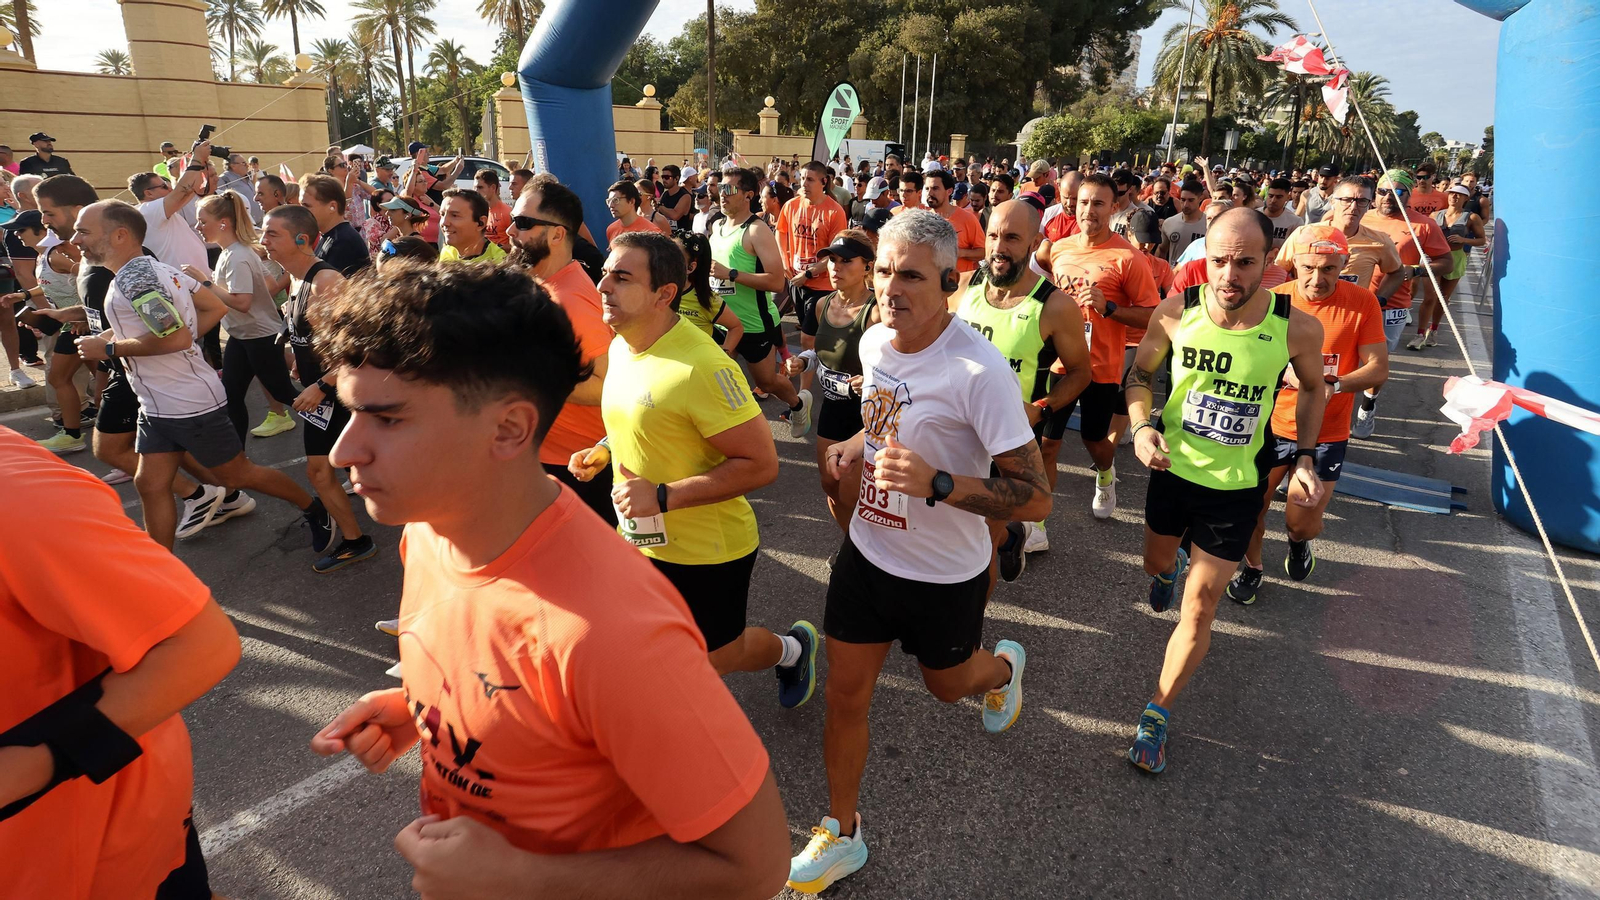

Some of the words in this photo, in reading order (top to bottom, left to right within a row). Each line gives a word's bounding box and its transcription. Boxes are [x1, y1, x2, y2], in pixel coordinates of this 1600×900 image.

[1182, 346, 1233, 374] BRO
[1213, 379, 1268, 402] TEAM
[1196, 409, 1245, 433] 1106
[1206, 432, 1247, 445] MIZUNO
[861, 480, 889, 509] 503
[861, 509, 903, 528] MIZUNO
